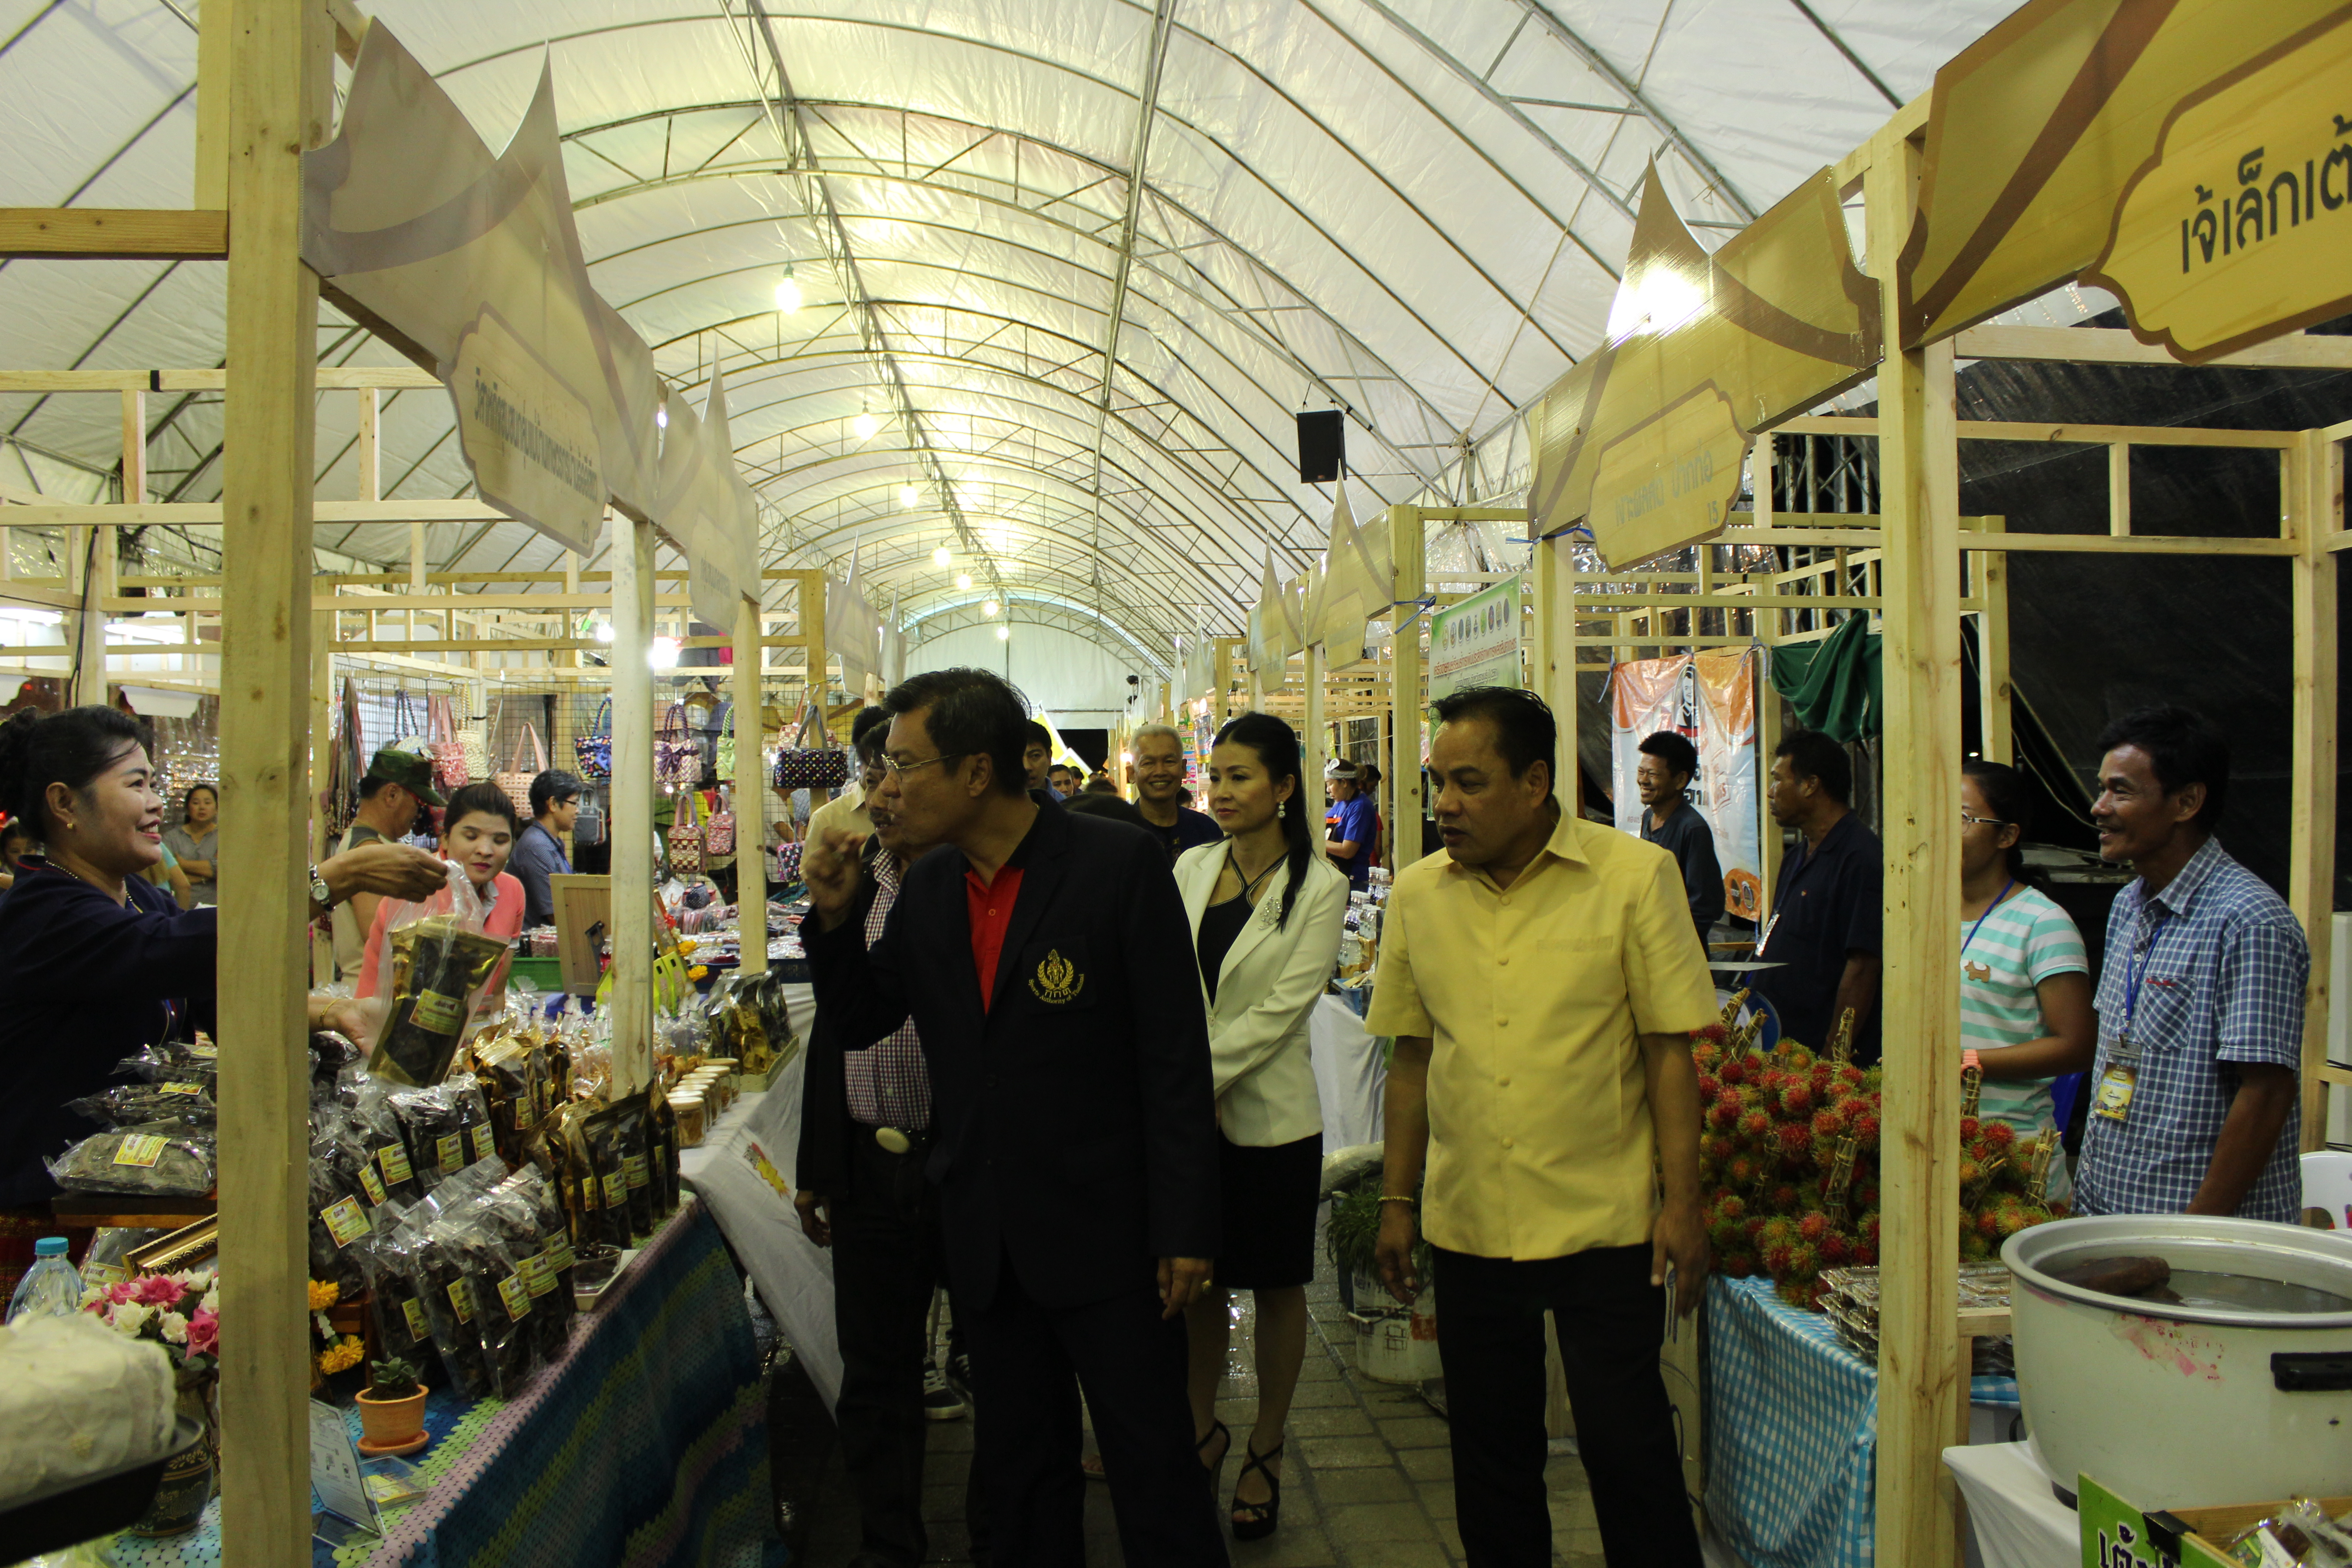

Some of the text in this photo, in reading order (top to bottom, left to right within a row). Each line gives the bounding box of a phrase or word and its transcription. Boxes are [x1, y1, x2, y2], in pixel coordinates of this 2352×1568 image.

[1672, 438, 1713, 499] ปากท่อ
[1707, 500, 1718, 525] 15
[1028, 979, 1039, 996] Sports
[1039, 995, 1065, 1004] Authority
[1072, 974, 1084, 996] Thailand
